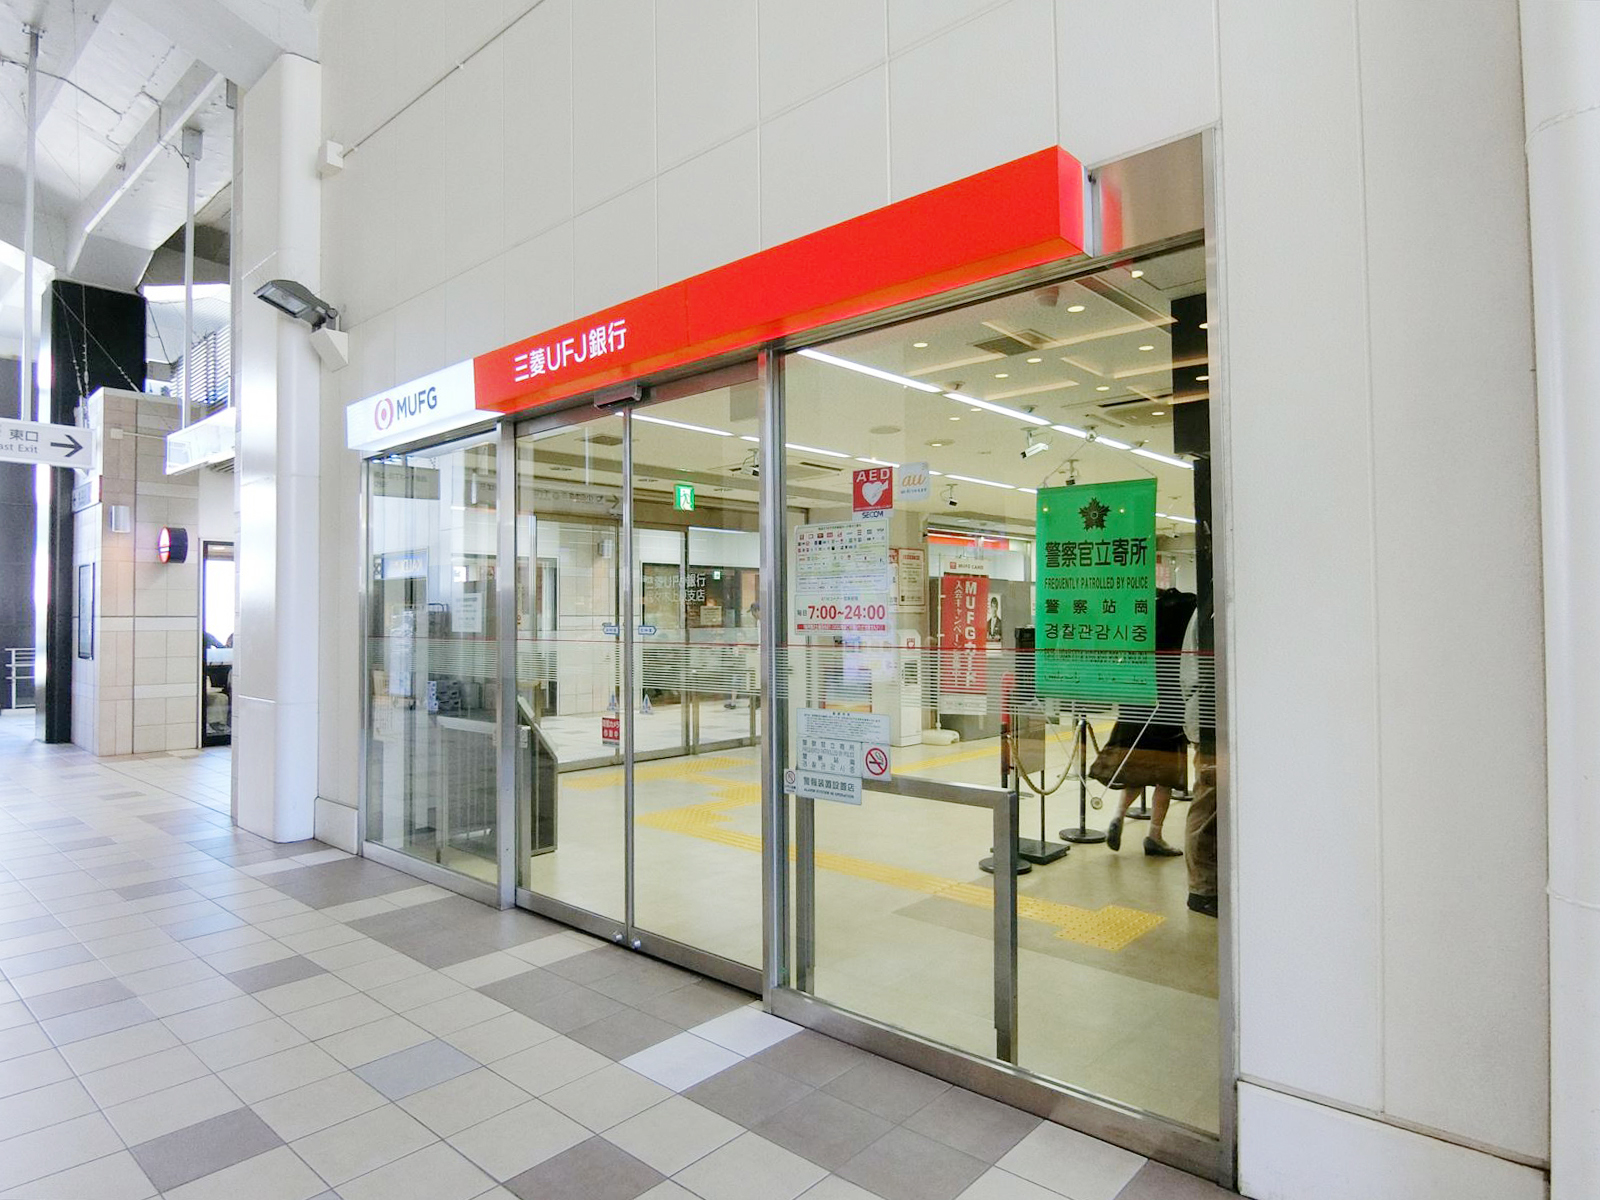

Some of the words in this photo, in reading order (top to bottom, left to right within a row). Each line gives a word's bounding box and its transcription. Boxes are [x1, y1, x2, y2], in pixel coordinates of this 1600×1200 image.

[514, 318, 627, 382] 三菱UFJ銀行
[396, 387, 438, 420] MUFG
[8, 429, 38, 442] 東口
[0, 443, 13, 451] ast
[18, 444, 38, 454] Exit
[856, 468, 891, 482] AED
[861, 510, 884, 519] SECOM
[1045, 537, 1148, 568] 警察官立寄所
[1044, 577, 1080, 590] FREQUENTLY
[1081, 576, 1115, 590] PATROLLED
[1116, 576, 1125, 589] BY
[1126, 575, 1149, 589] POLICE
[1044, 623, 1148, 642] 경찰관감시중
